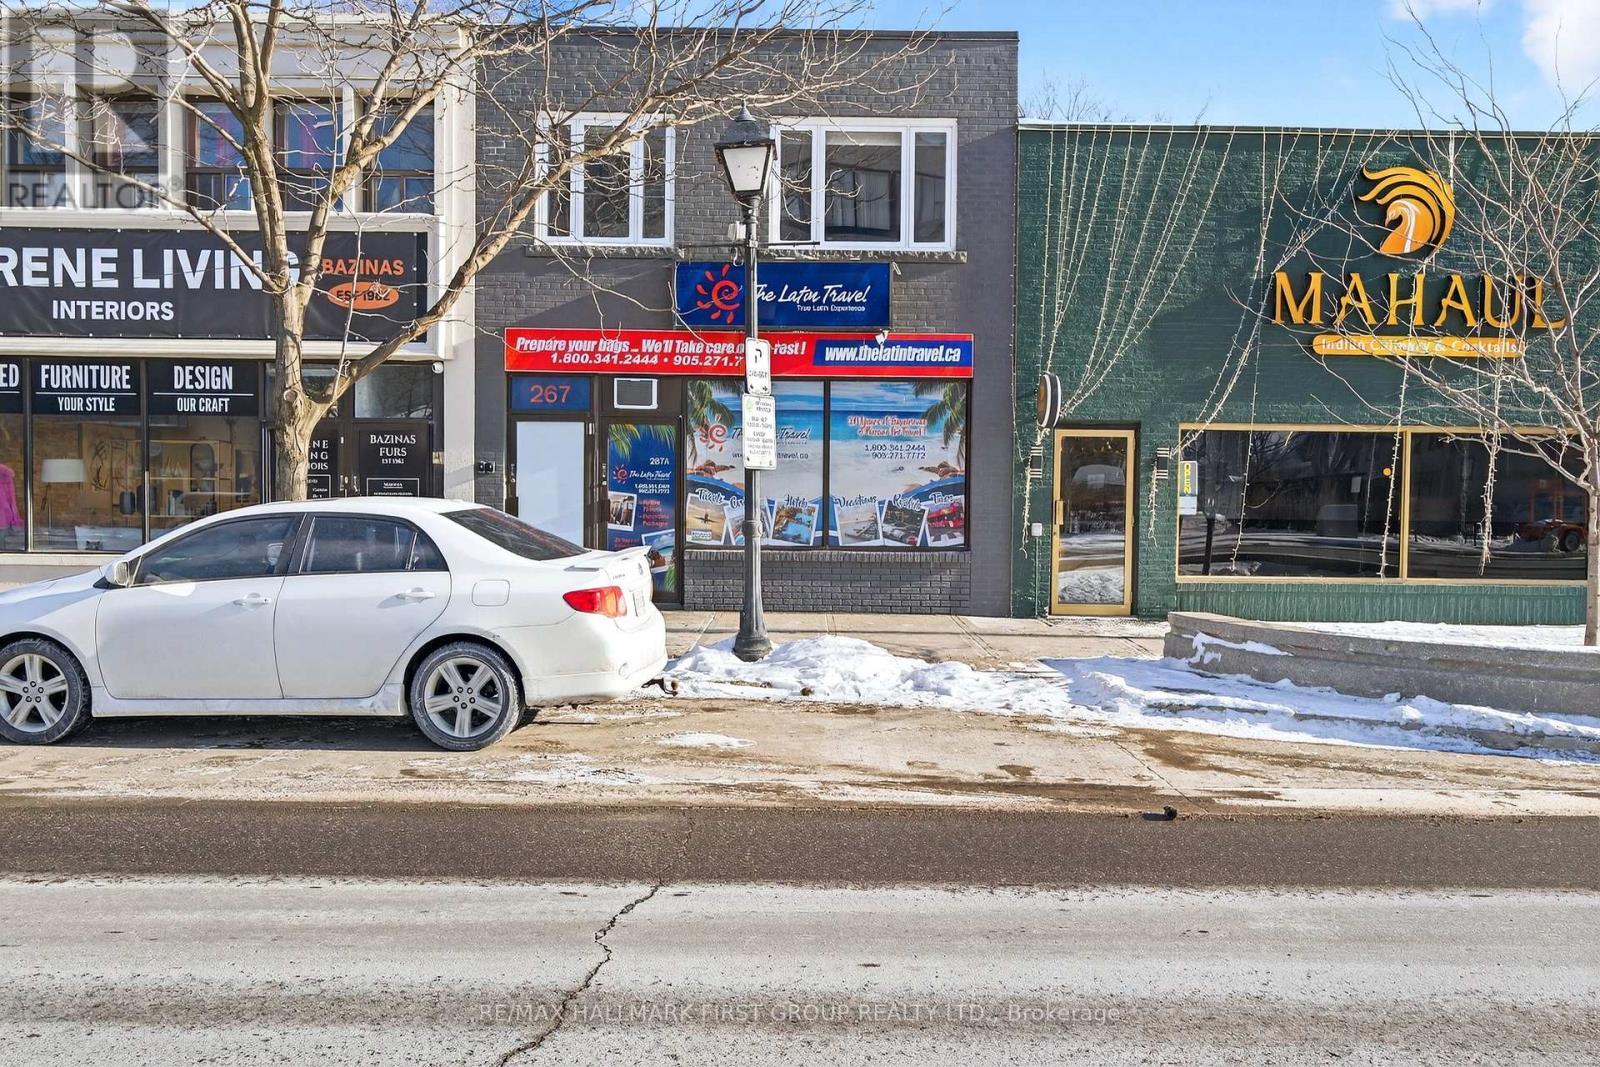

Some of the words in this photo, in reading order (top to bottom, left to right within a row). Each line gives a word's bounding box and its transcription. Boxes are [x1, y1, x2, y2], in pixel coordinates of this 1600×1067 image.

[323, 258, 405, 276] BAZINAS
[778, 284, 821, 304] Latin
[822, 284, 872, 304] Travel
[1272, 271, 1567, 329] MAHAUL
[52, 300, 175, 321] INTERIORS
[516, 337, 565, 353] Prepare
[568, 340, 596, 354] your
[675, 340, 703, 353] Take
[825, 344, 961, 362] www.thelatintravel.ca
[550, 353, 658, 365] 1.800.341.2444
[673, 355, 744, 367] 905.271.7
[41, 365, 131, 390] FURNITURE
[174, 365, 233, 390] DESIGN
[530, 384, 571, 403] 267
[58, 397, 84, 412] YOUR
[86, 397, 115, 412] STYLE
[177, 397, 196, 412] OUR
[199, 398, 229, 412] CRAFT
[370, 435, 416, 444] BAZINAS
[780, 426, 811, 440] Travel
[379, 447, 407, 457] FURS
